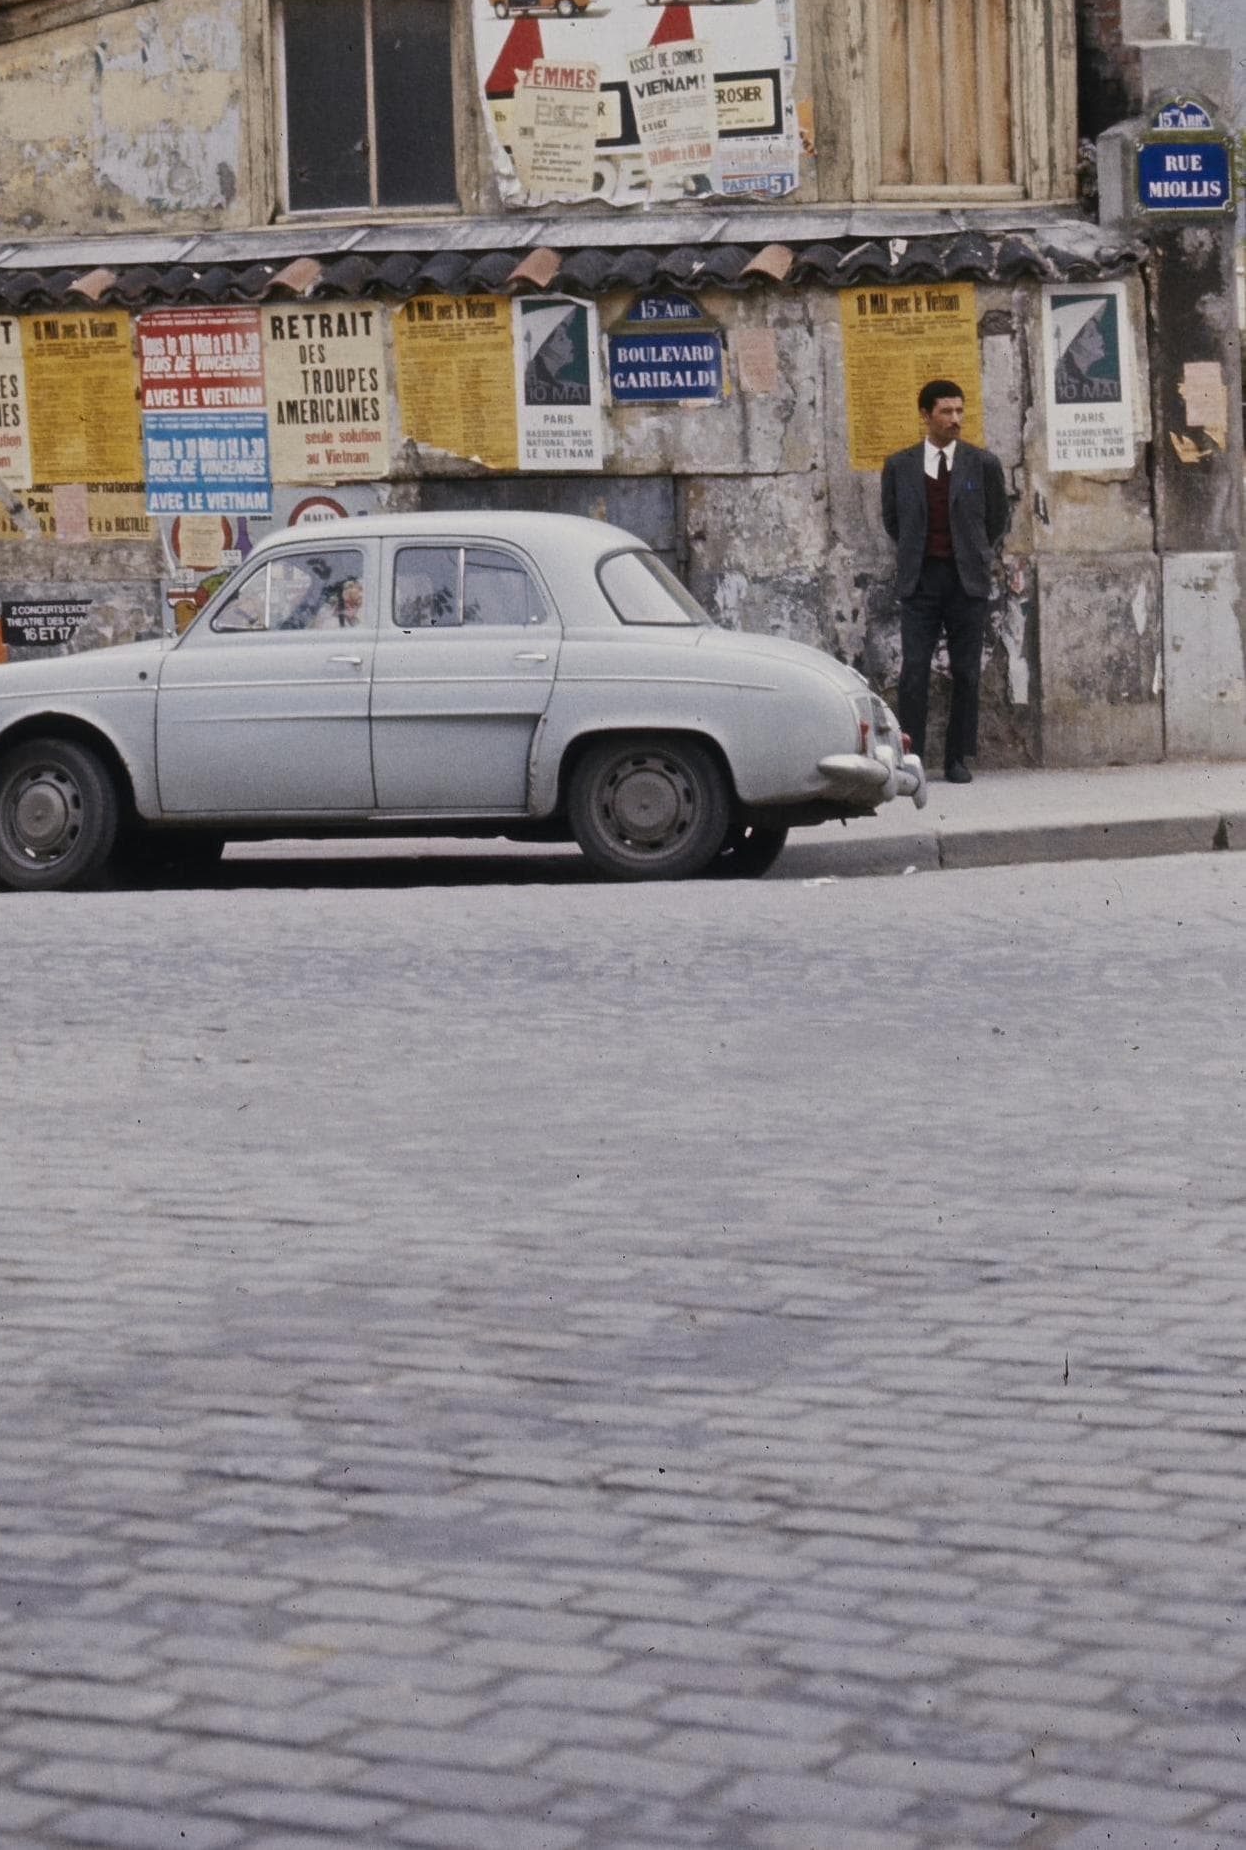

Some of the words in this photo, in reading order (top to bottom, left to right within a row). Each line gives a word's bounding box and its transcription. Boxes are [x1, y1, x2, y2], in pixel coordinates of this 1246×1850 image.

[630, 54, 654, 74] ASSEZ
[1165, 155, 1202, 171] RUE
[722, 177, 768, 193] PASTIS
[1149, 180, 1221, 198] MIOLLIS
[271, 311, 373, 340] RETRAIT
[299, 344, 326, 364] DES
[617, 345, 714, 363] BOULEVARD
[174, 356, 192, 372] DE
[195, 353, 260, 371] VINCENNES
[301, 367, 378, 394] TROUPES
[614, 370, 717, 388] GARIBALDI
[145, 389, 179, 407] AVEC
[182, 389, 198, 406] LE
[201, 386, 263, 405] VIETNAM
[277, 397, 380, 425] AMERICAINES
[543, 414, 574, 424] PARIS
[1074, 412, 1105, 423] PARIS
[305, 430, 333, 444] seule
[339, 429, 381, 443] solution
[526, 430, 592, 438] RASSEMBLEMENT
[526, 439, 565, 447] NATIONAL
[572, 439, 593, 447] POUR
[306, 452, 319, 464] au
[325, 449, 369, 464] Vietnam
[527, 449, 538, 459] LE
[545, 448, 594, 459] VIETNAM
[1057, 449, 1069, 459] LE
[1076, 447, 1125, 458] VIETNAM
[200, 459, 265, 475] VINCENNES
[27, 498, 49, 513] Paix
[150, 492, 184, 510] AVEC
[187, 492, 203, 509] LE
[206, 491, 268, 510] VIETNAM
[115, 516, 150, 531] BASTILLE
[11, 606, 17, 615] 2
[18, 604, 64, 614] CONCERTS
[7, 617, 44, 627] THEATRE
[46, 616, 64, 626] DES
[23, 627, 38, 641] 16
[40, 627, 56, 640] ET
[58, 626, 71, 640] 17
